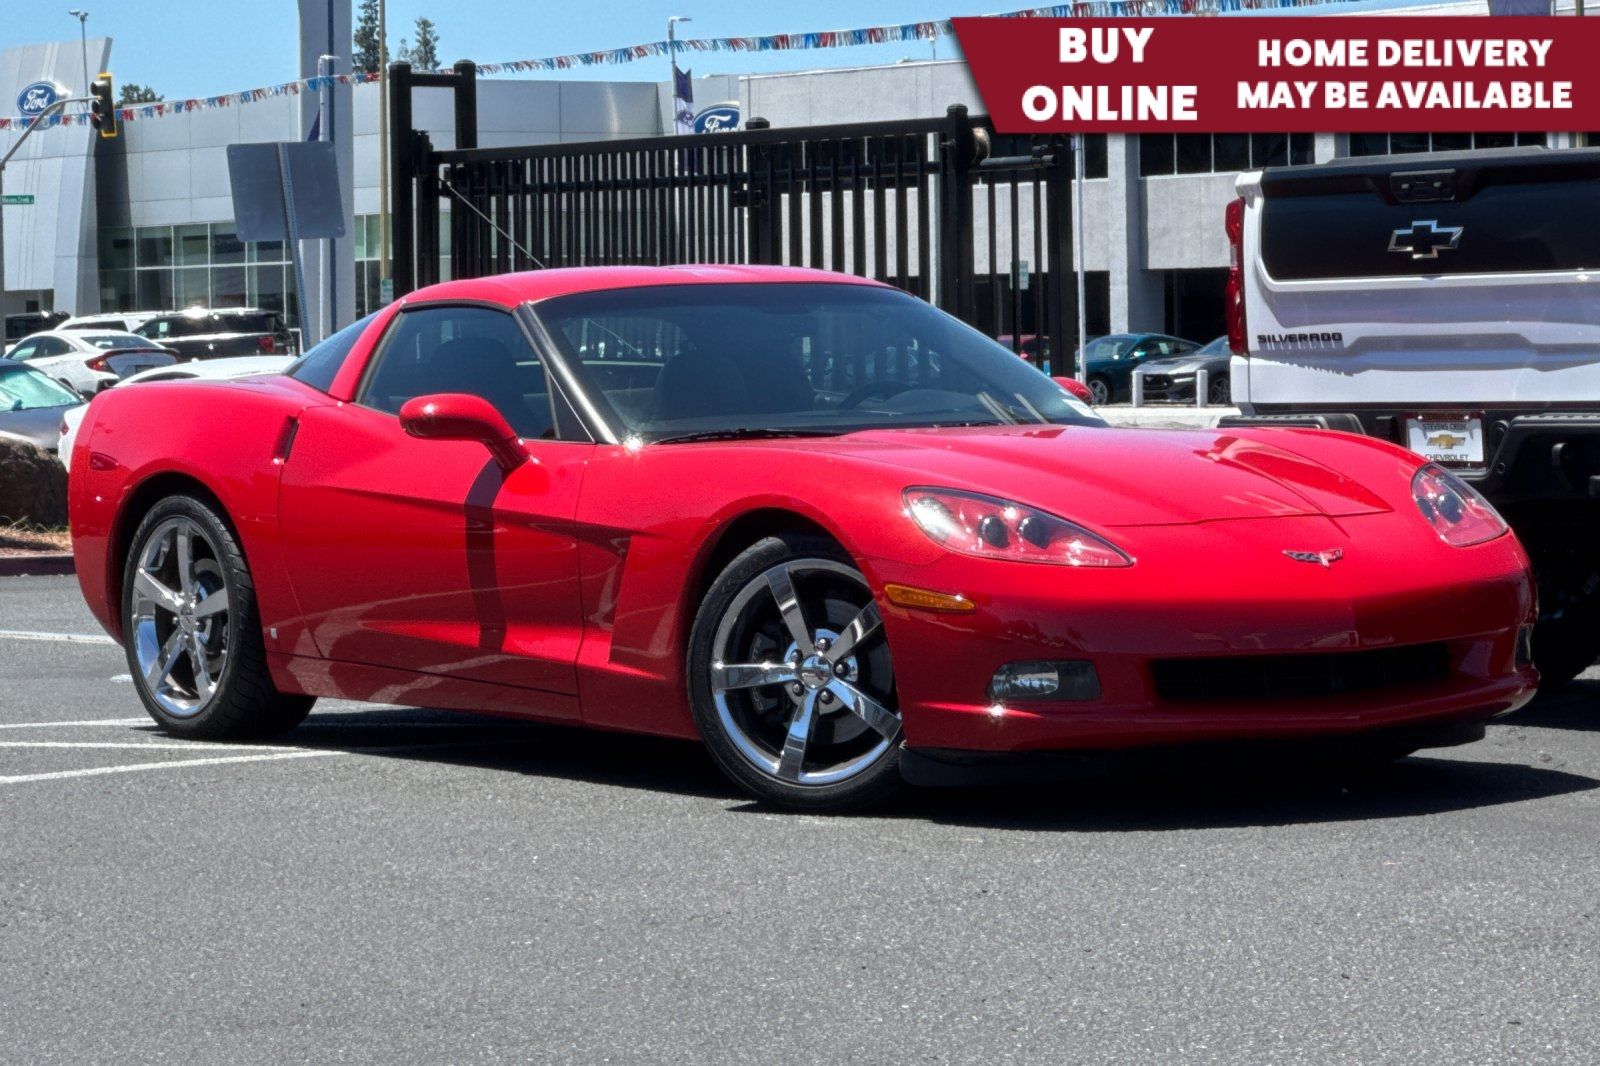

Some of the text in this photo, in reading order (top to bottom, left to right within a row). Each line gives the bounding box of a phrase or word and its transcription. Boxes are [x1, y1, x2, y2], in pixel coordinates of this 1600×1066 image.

[24, 89, 50, 110] Ford
[1257, 332, 1343, 343] SILVERADO
[1422, 423, 1449, 431] STEVENS
